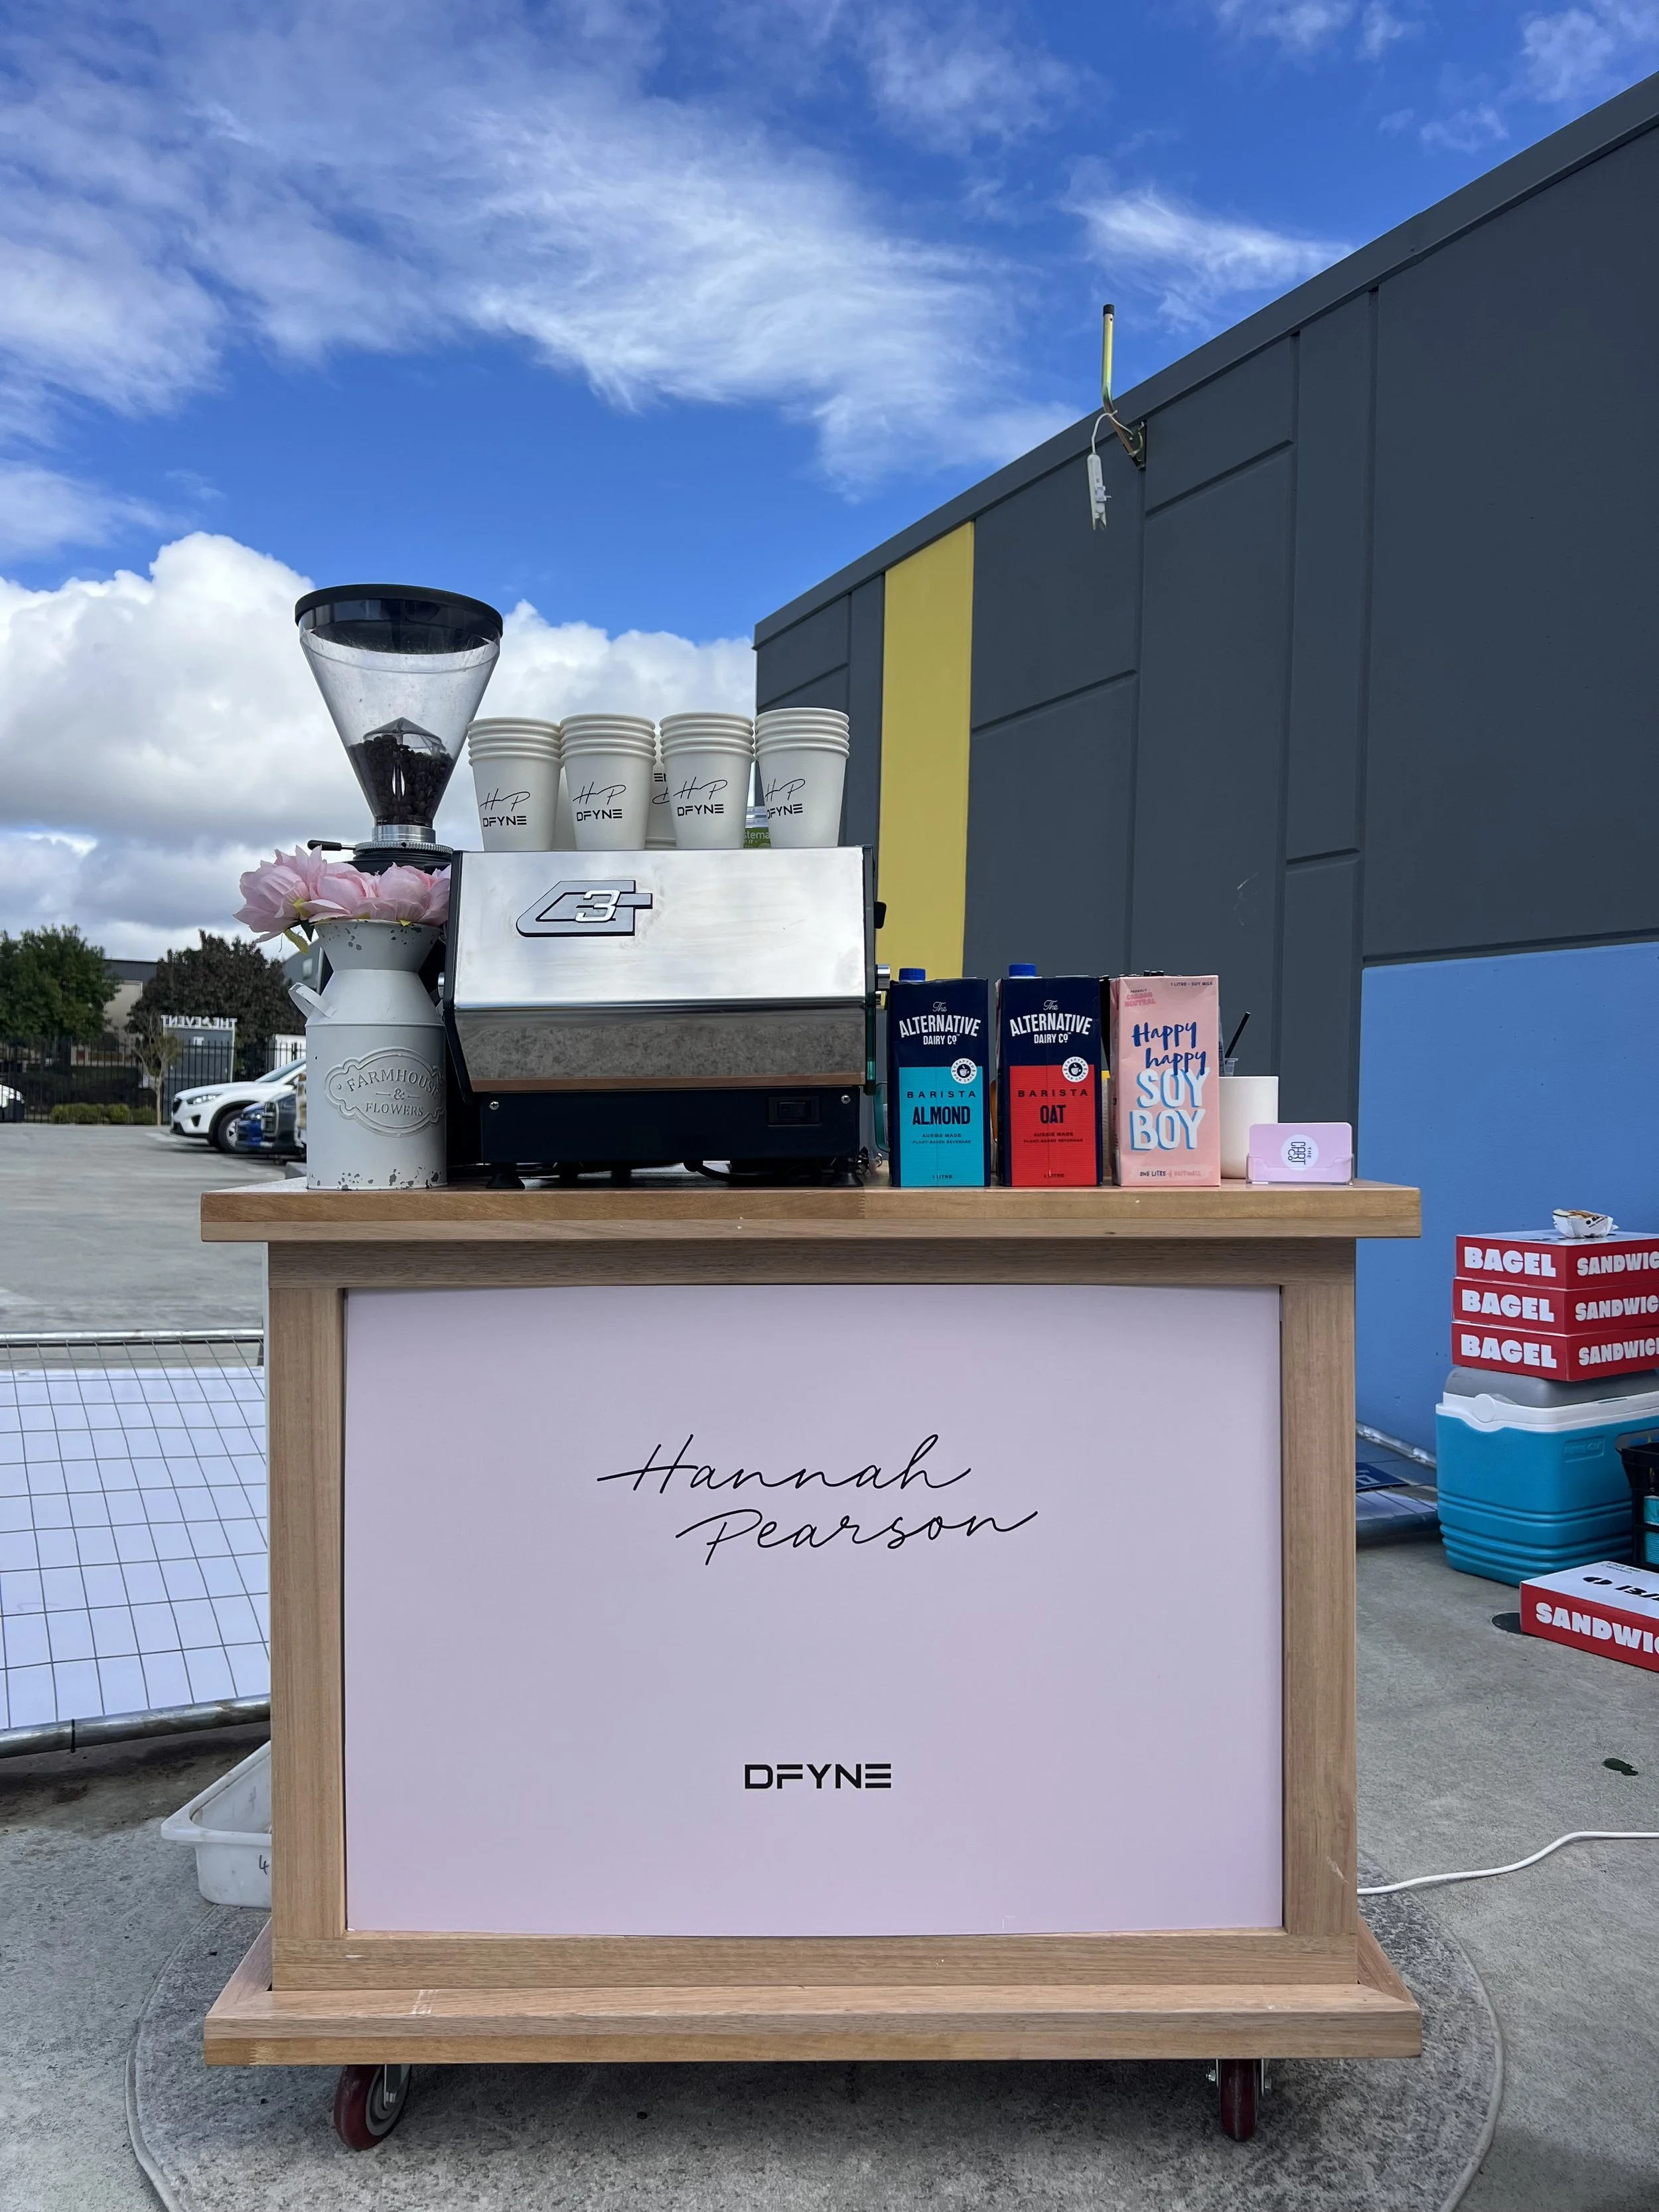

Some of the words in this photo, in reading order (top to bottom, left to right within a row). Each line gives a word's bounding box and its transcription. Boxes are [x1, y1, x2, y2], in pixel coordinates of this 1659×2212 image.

[483, 816, 527, 827] DFYNE
[576, 809, 622, 822] DFYNE
[677, 804, 724, 816] DFYNE
[899, 1015, 981, 1038] ALTERNATIVE
[1009, 1013, 1093, 1037] ALTERNATIVE
[1131, 1022, 1196, 1051] Happy
[923, 1035, 945, 1045] DAIRY
[1034, 1034, 1056, 1043] DAIRY
[1145, 1048, 1206, 1076] happy
[346, 1069, 440, 1099] FARMHOUSE
[393, 1088, 405, 1100] &
[1018, 1088, 1088, 1097] BARISTA
[1137, 1067, 1210, 1108] SOY
[366, 1103, 423, 1116] FLOWERS
[912, 1106, 970, 1125] ALMOND
[1040, 1105, 1066, 1124] OAT
[1129, 1109, 1206, 1151] BOY
[1291, 1142, 1306, 1165] CART
[1464, 1246, 1556, 1277] BAGEL
[1462, 1290, 1554, 1322] BAGEL
[1461, 1334, 1557, 1368] BAGEL
[597, 1434, 972, 1494] Hannah
[675, 1508, 1038, 1566] Pearson
[745, 1763, 891, 1789] DFYNE
